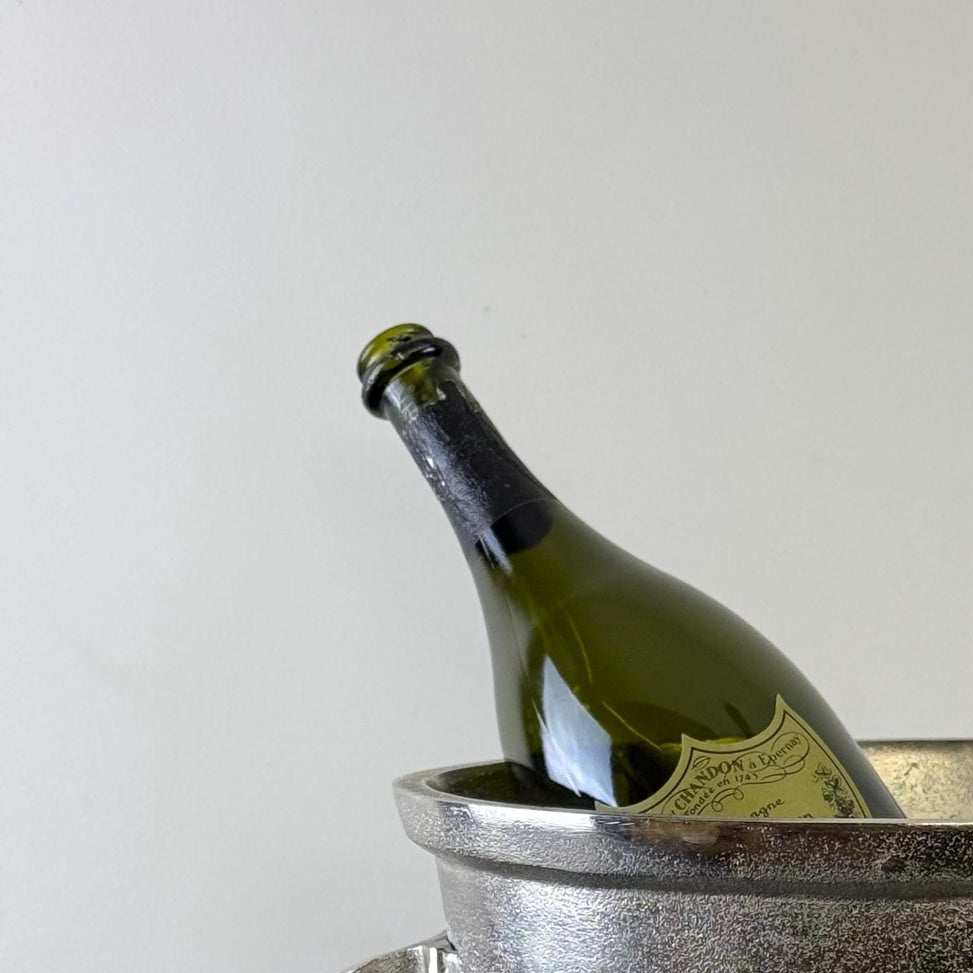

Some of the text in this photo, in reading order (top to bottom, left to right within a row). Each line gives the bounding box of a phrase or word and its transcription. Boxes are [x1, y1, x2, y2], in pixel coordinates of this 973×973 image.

[674, 759, 744, 811] CHANDON
[717, 779, 731, 788] en
[750, 798, 785, 818] agne
